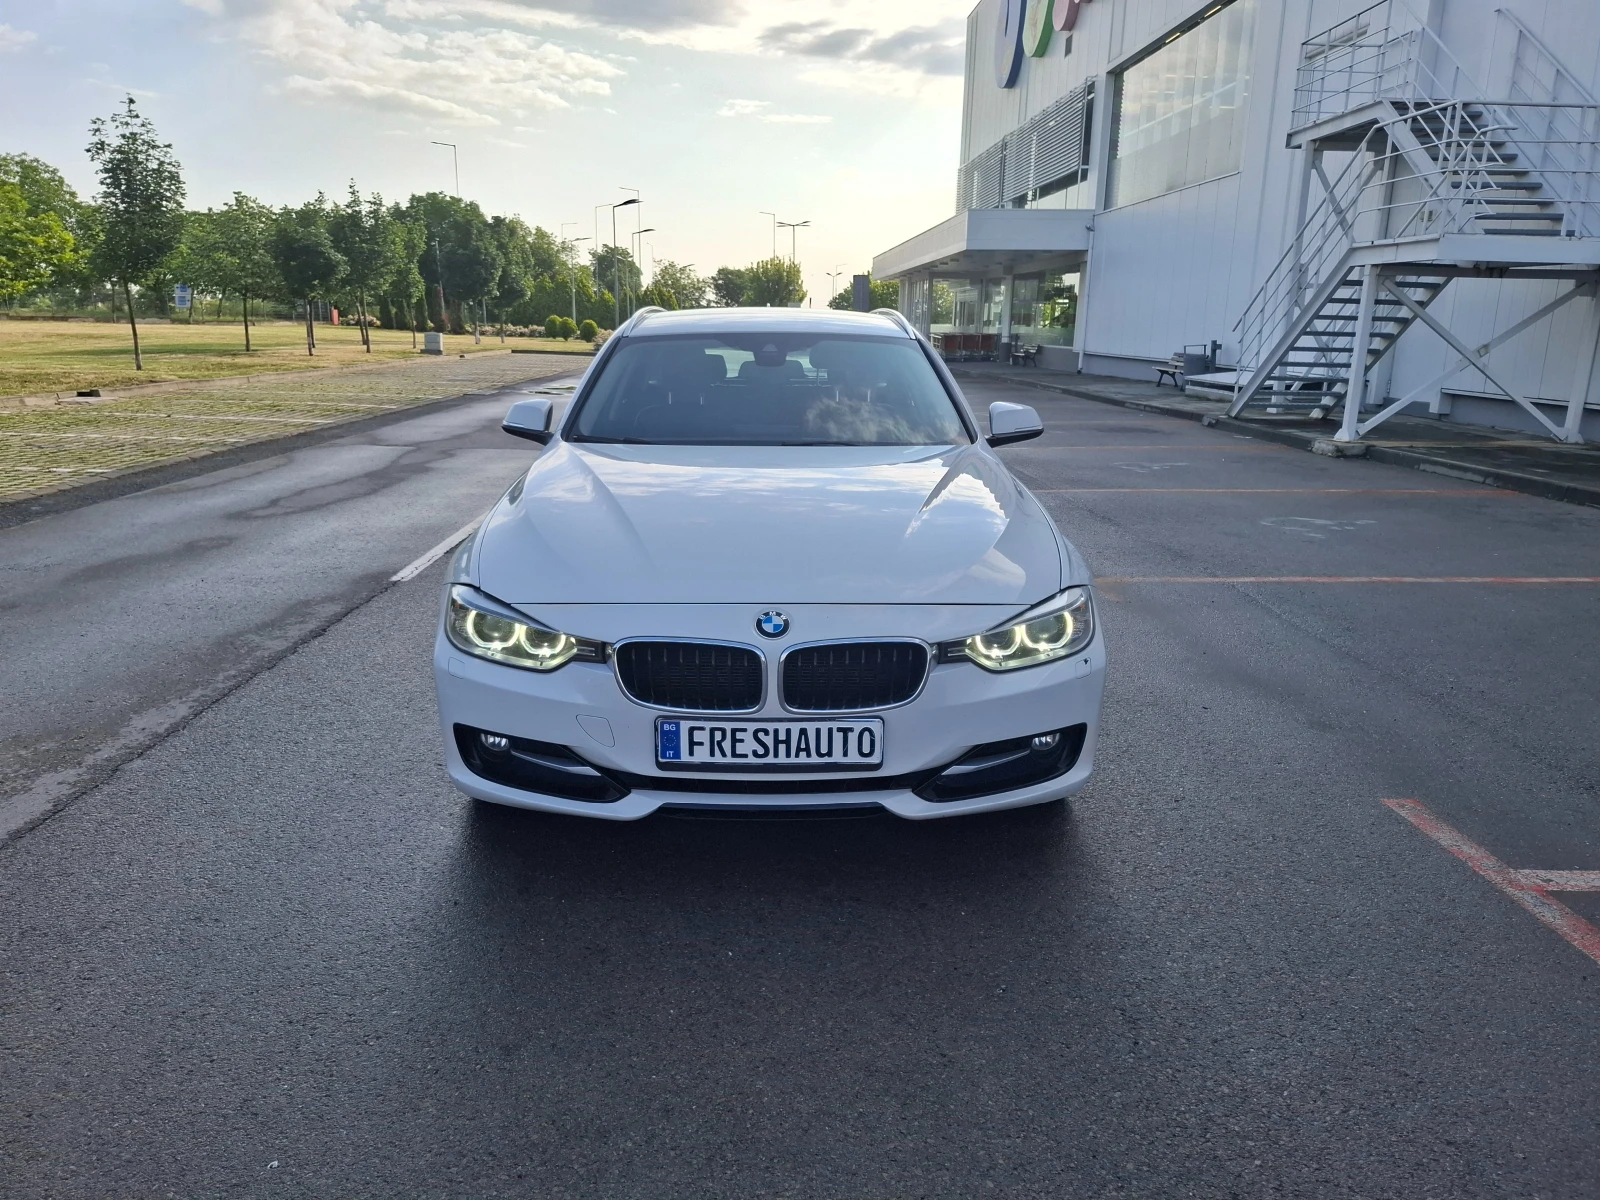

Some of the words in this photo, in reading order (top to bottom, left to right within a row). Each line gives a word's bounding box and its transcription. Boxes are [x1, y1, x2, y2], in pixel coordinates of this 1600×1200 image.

[759, 611, 787, 620] BMW
[663, 723, 676, 731] BG
[687, 725, 876, 759] FRESHAUTO
[666, 750, 675, 758] IT
